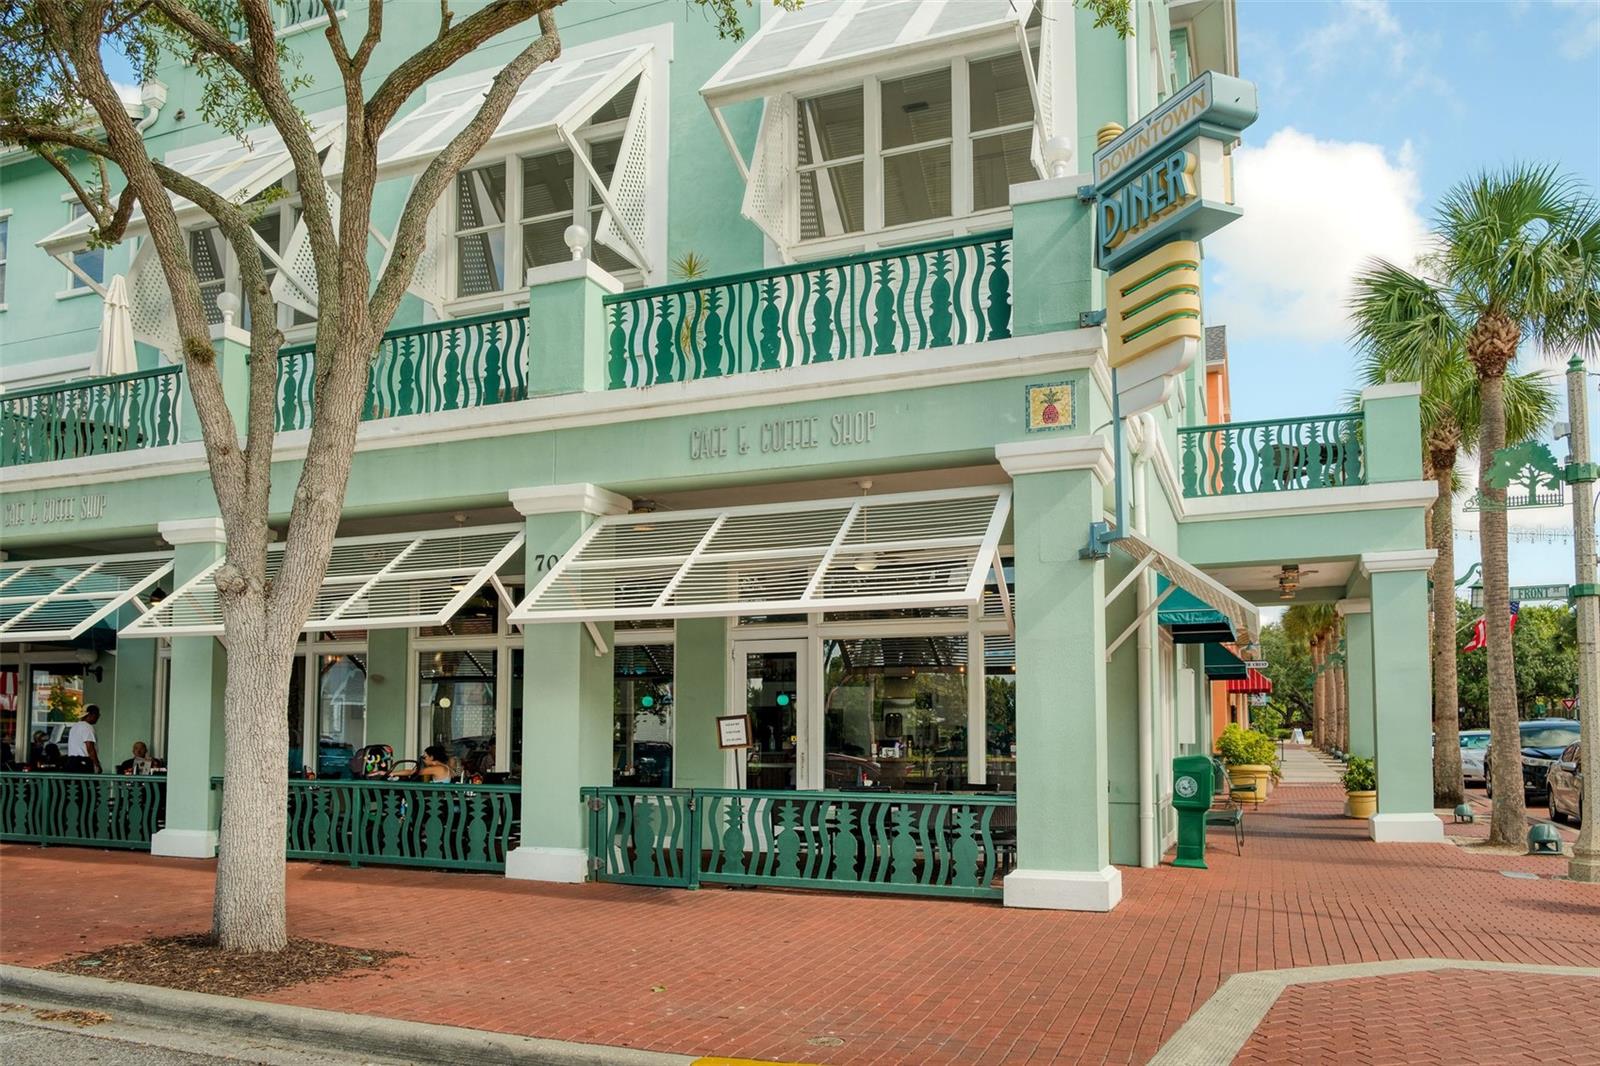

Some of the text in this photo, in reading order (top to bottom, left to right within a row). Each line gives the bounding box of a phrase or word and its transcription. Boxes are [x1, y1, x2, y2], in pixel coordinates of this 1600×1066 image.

[1098, 88, 1207, 180] DOWNTOWN
[1099, 150, 1194, 248] DINER
[738, 425, 751, 456] &
[760, 416, 820, 454] COFFEE
[831, 409, 877, 446] SHOP
[42, 496, 75, 524] COFFEE
[80, 494, 107, 519] SHOP
[535, 553, 564, 572] 70
[1518, 587, 1549, 600] FRONT
